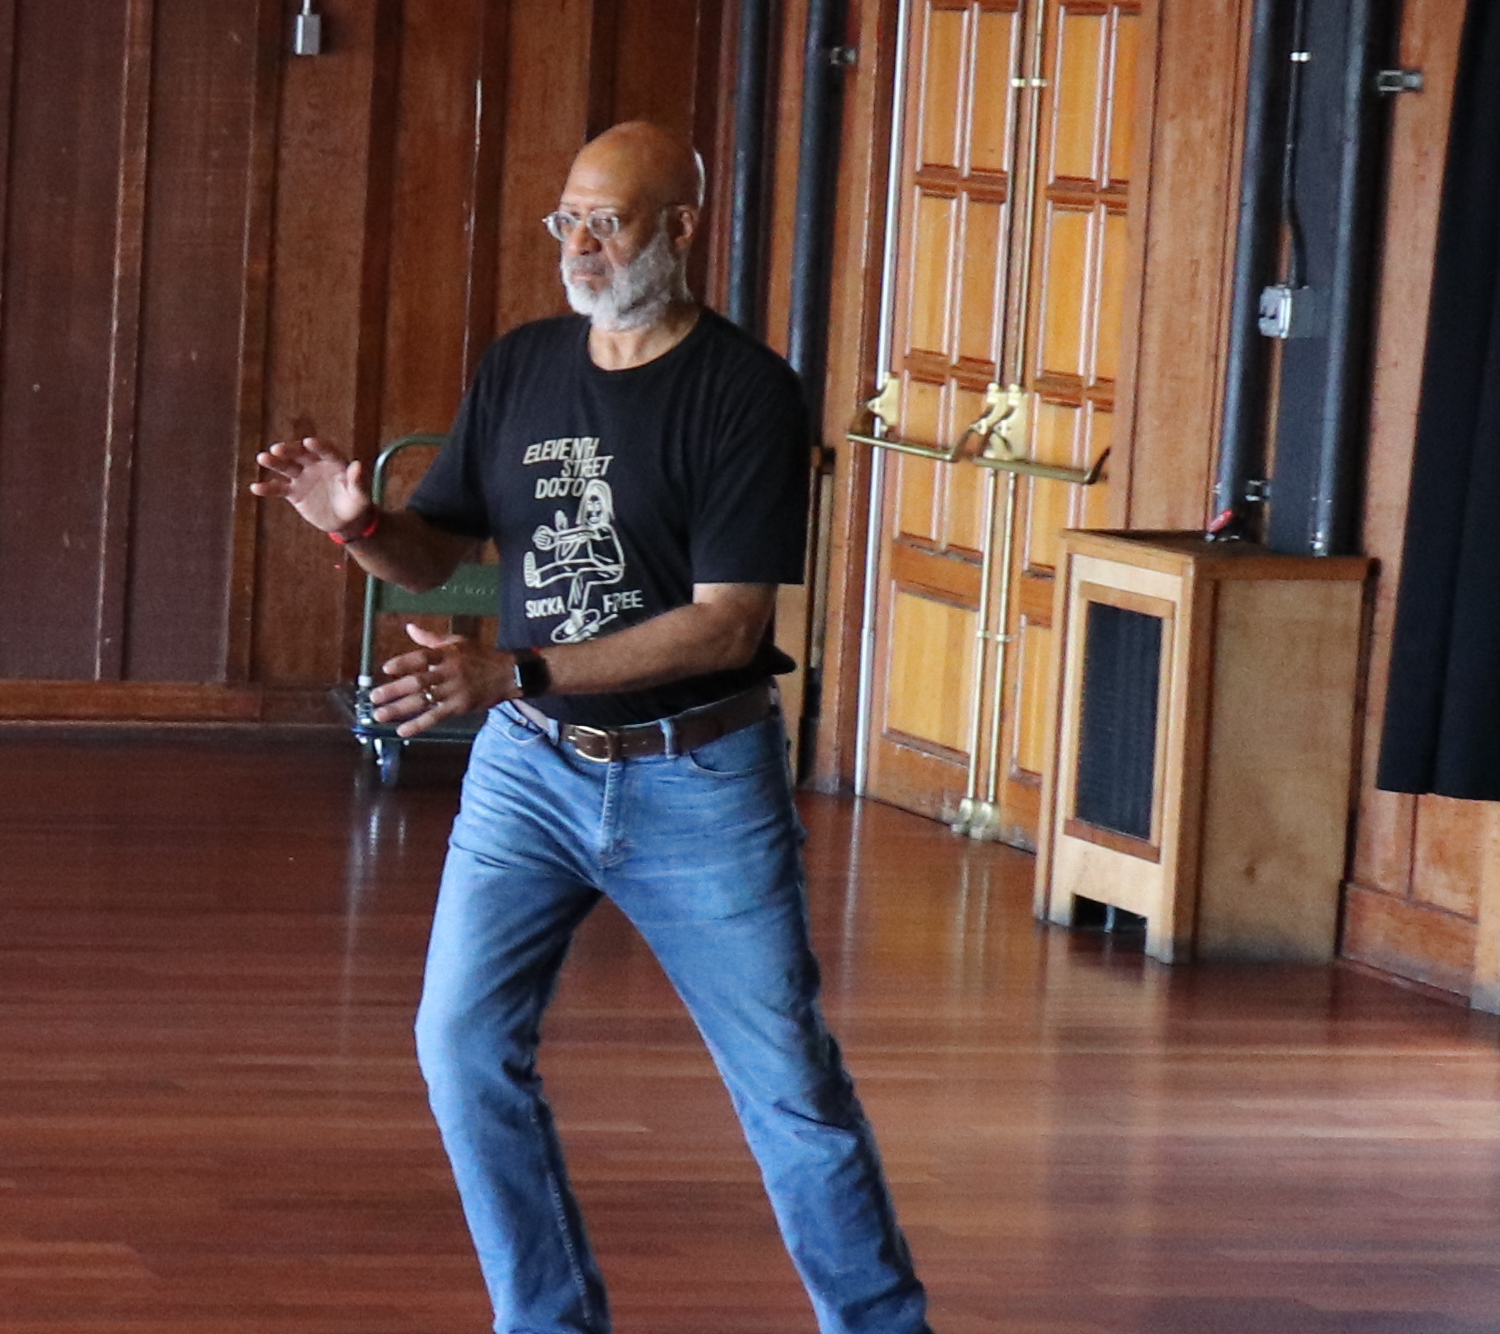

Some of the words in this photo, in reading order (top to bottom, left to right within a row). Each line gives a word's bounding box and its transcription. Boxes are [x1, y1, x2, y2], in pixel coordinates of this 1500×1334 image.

[561, 455, 615, 478] STREET
[534, 477, 586, 499] DOJO
[525, 596, 566, 618] SUCKA
[603, 589, 644, 613] FREE
